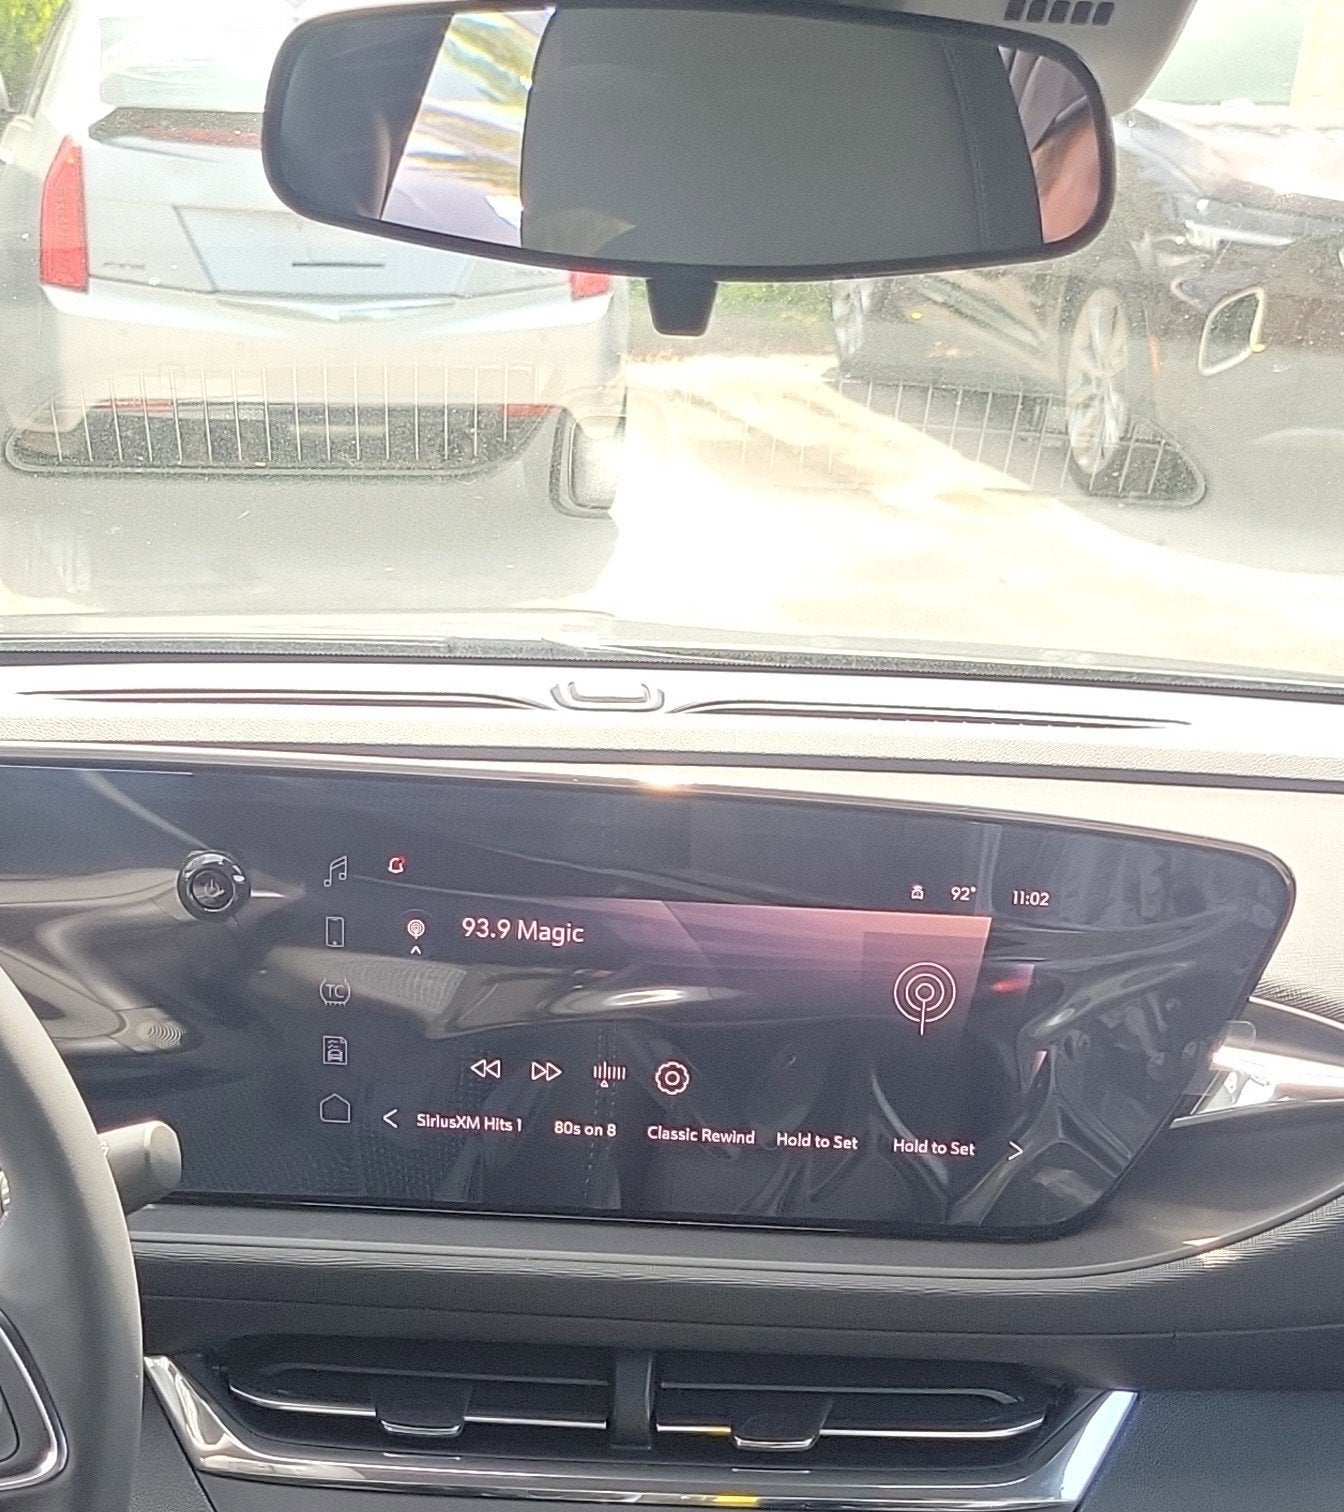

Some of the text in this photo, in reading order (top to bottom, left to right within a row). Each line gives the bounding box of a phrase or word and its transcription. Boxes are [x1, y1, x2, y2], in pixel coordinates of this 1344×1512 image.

[1013, 890, 1050, 906] 11:02
[461, 917, 585, 947] 93.9 Magic
[417, 1114, 480, 1130] SiriusXM
[484, 1116, 513, 1131] Hits
[554, 1121, 617, 1137] 80s on 8
[647, 1126, 755, 1145] Classic Rewind
[776, 1131, 858, 1150] Hold to Set
[893, 1138, 976, 1157] Hold to Set
